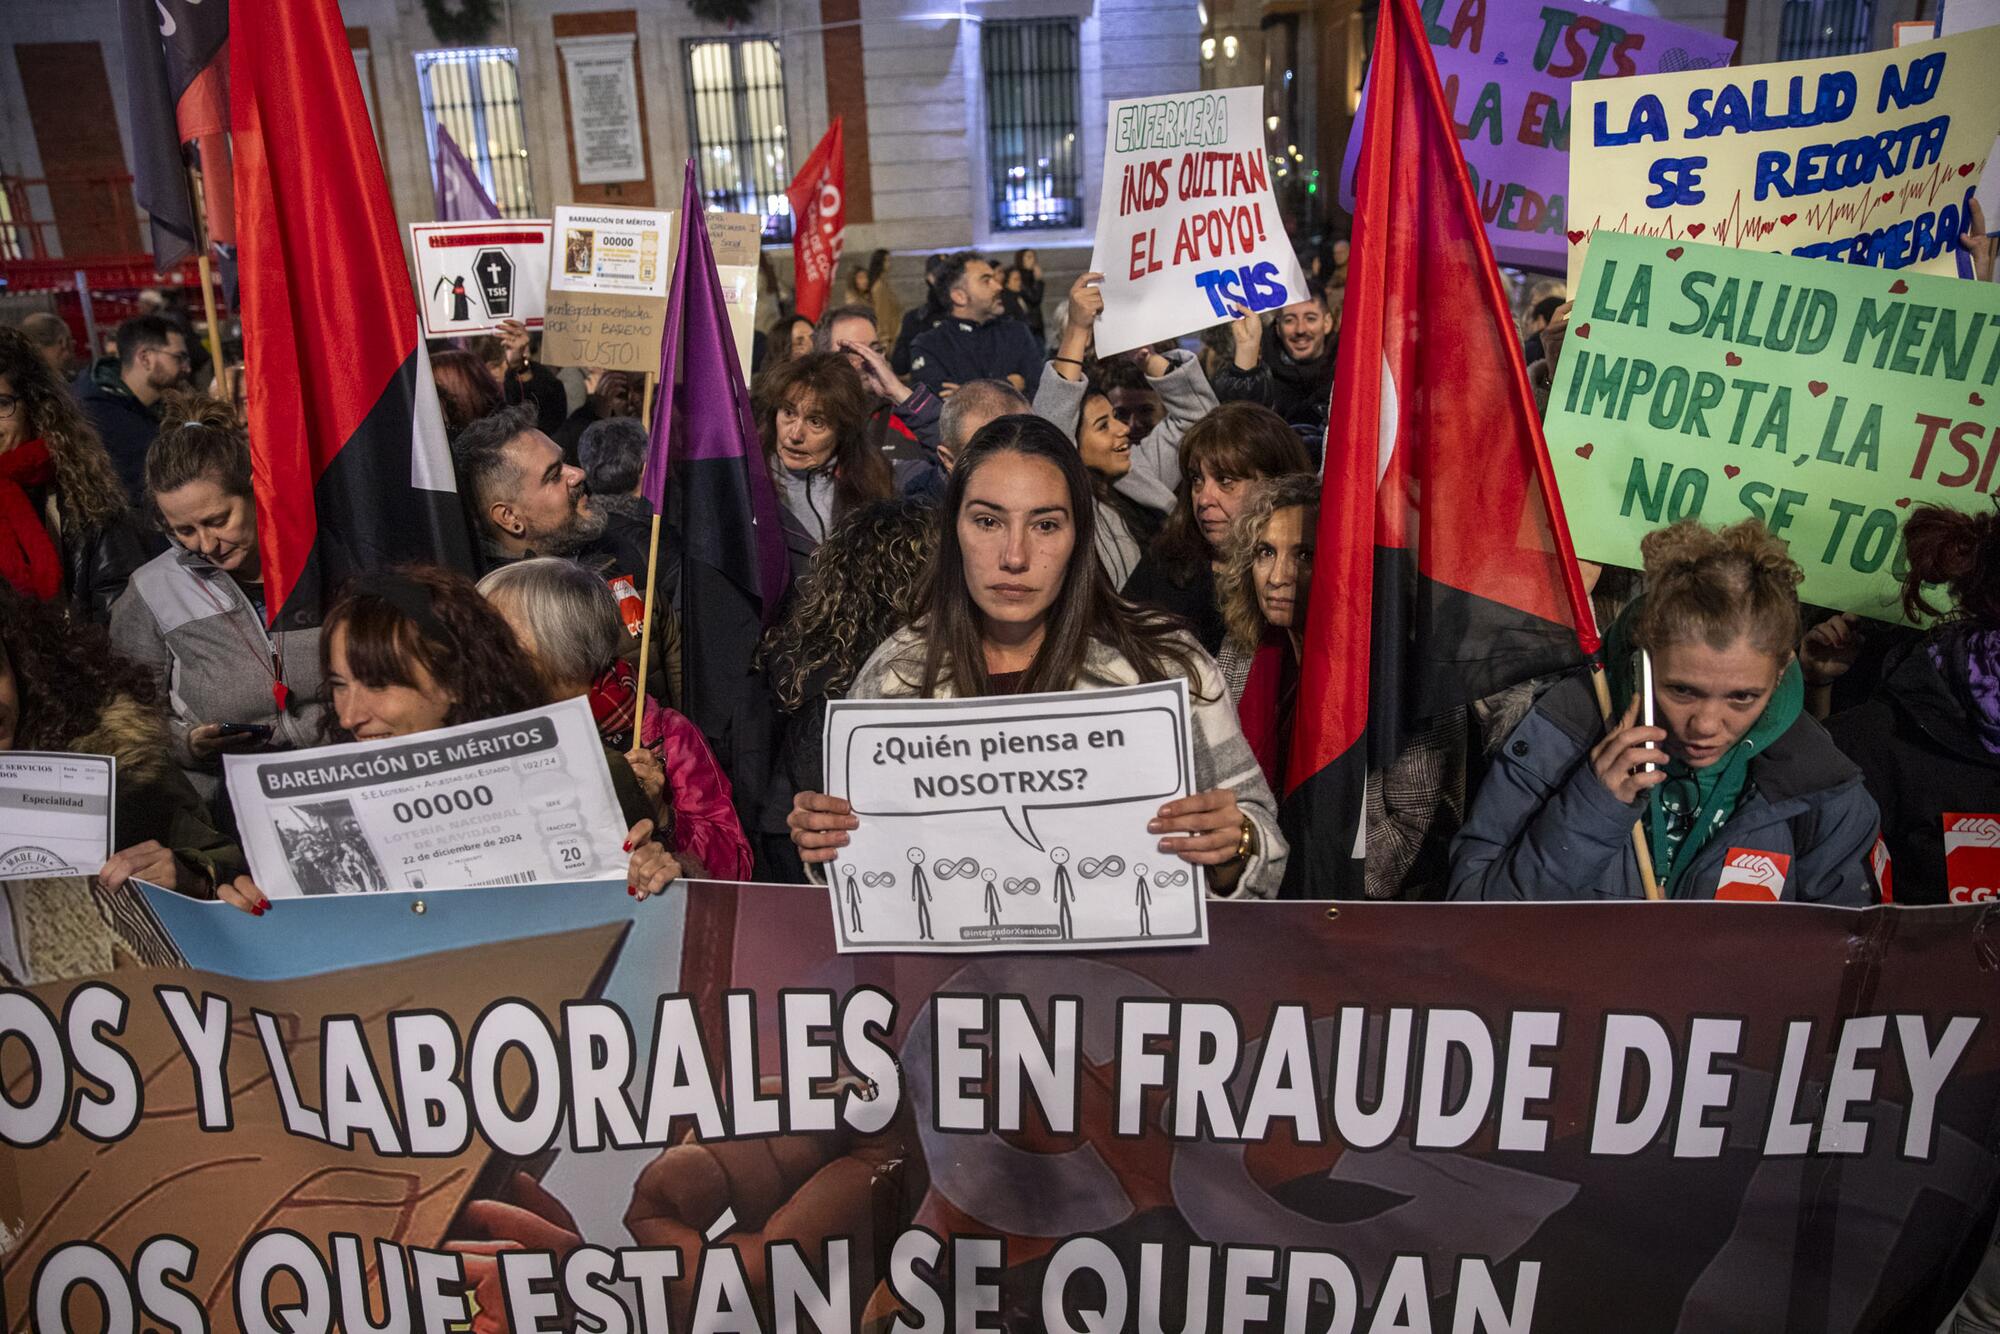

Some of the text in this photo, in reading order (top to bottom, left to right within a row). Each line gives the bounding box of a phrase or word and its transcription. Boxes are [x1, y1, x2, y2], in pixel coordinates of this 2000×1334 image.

[1421, 0, 1487, 54] LA
[1444, 74, 1571, 151] LA EN
[1593, 51, 1948, 148] LA SALUD NO
[1114, 94, 1228, 153] ENFERMERA
[1119, 147, 1268, 217] ¡NOS QUITAN
[1645, 115, 1951, 210] SE RECORTA
[1466, 161, 1569, 237] UEDA
[568, 214, 656, 227] BAREMACIÓN DE MÉRITOS
[602, 236, 634, 247] 00000
[1129, 202, 1266, 281] EL APOYO!
[487, 287, 508, 297] TSIS
[1195, 261, 1288, 319] TSIS
[1591, 259, 1654, 329] LA
[1668, 270, 1839, 356] SALUD
[601, 322, 652, 337] BAREMO
[1909, 413, 2000, 498] TSI
[1619, 457, 1710, 525] NO
[266, 727, 544, 791] BAREMACIÓN DE MÉRITOS
[523, 757, 557, 770] 102/24
[872, 727, 1125, 766] ¿Quién piensa en
[0, 771, 18, 779] DOS
[5, 763, 53, 772] SERVICIOS
[913, 767, 1088, 800] NOSOTRXS?
[22, 793, 84, 808] Especialidad
[393, 785, 494, 824] 00000
[384, 807, 521, 845] LOTERÍA NACIONAL
[438, 824, 501, 846] NAVIDAD
[6, 852, 48, 867] MADE IN
[401, 833, 523, 865] 22 de diciembre de 2024
[560, 846, 582, 862] 20
[1949, 886, 2000, 904] CG
[962, 927, 1058, 938] @integradorXsenlucha
[157, 988, 231, 1130] Y
[251, 988, 902, 1157] LABORALES
[936, 995, 1079, 1134] EN
[1117, 1000, 1563, 1153] FRAUDE
[1589, 1012, 1744, 1159] DE
[1762, 1012, 1982, 1160] LEY
[35, 1206, 1543, 1334] OS QUE ESTÁN SE QUEDAN
